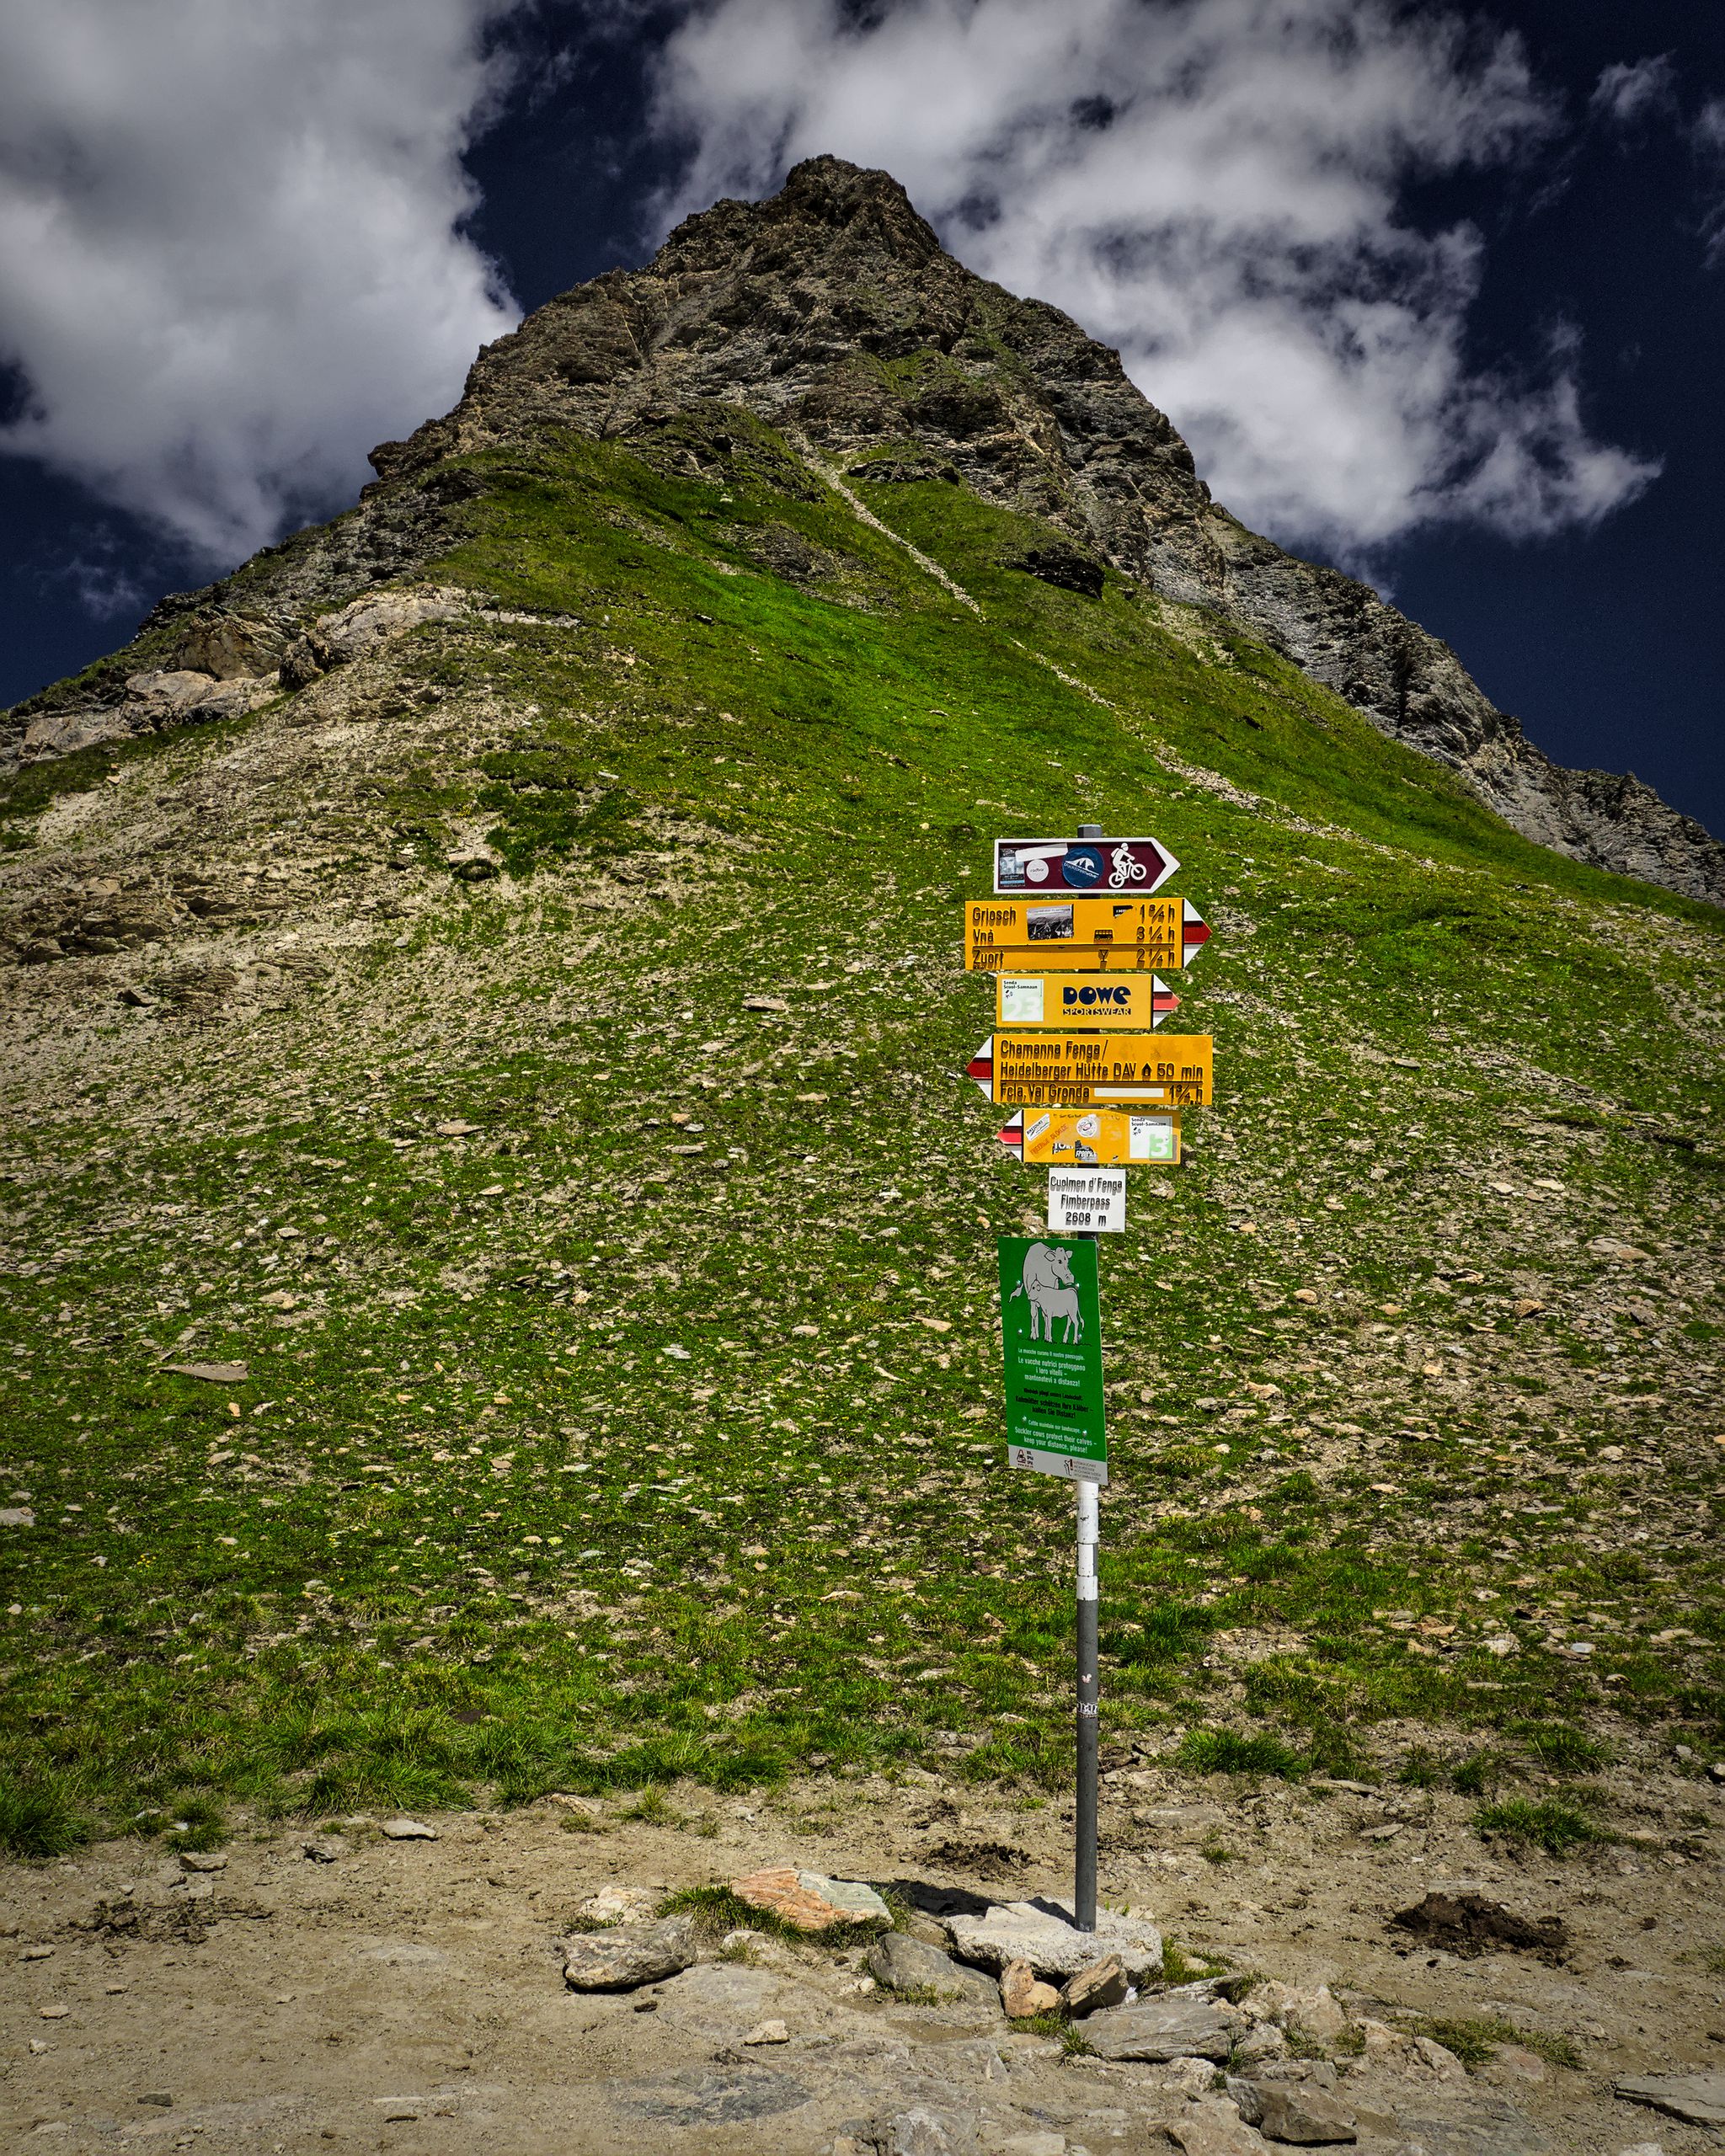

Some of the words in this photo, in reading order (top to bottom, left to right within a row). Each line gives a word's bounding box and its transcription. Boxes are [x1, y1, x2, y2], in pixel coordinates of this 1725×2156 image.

[973, 905, 1017, 921] Griosch
[1168, 904, 1175, 917] h
[1168, 926, 1175, 939] h
[973, 948, 1005, 964] Zuort
[1168, 947, 1175, 962] h
[1001, 1039, 1061, 1055] Chamanna
[1001, 1061, 1071, 1080] Heidelberger
[1076, 1062, 1108, 1076] Hütte
[1114, 1062, 1136, 1077] DAV
[1157, 1062, 1174, 1077] 50
[1181, 1064, 1203, 1078] min
[1028, 1083, 1044, 1098] Val
[1049, 1083, 1090, 1098] Gronda
[1196, 1085, 1203, 1098] h
[1050, 1176, 1086, 1187] Cuolmen
[1060, 1193, 1110, 1208] Fimberpass
[1065, 1211, 1091, 1223] 2608
[1097, 1214, 1107, 1224] m
[1045, 1432, 1063, 1441] protect
[1023, 1436, 1035, 1445] keep
[1070, 1444, 1088, 1454] please!
